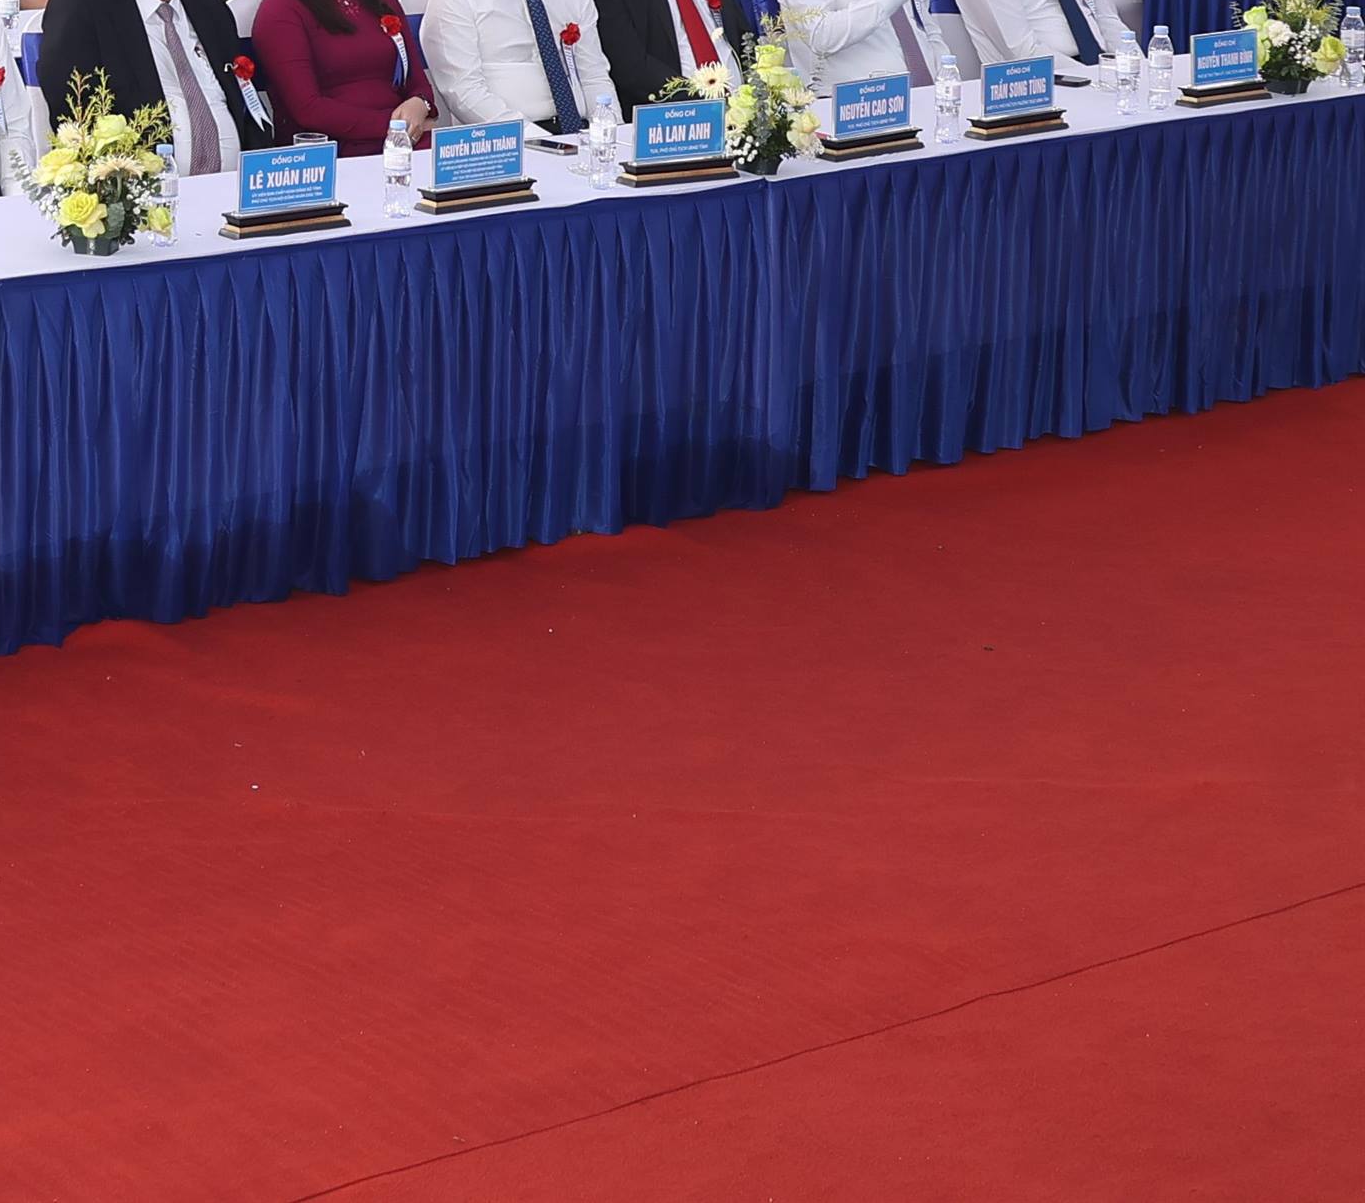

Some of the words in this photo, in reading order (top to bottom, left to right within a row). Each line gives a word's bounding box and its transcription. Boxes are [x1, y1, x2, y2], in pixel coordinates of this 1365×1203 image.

[1006, 67, 1021, 76] ĐỒNG
[1022, 64, 1031, 73] CHÍ
[1197, 50, 1221, 70] NGUYỄN
[1221, 52, 1238, 66] THANH
[859, 85, 875, 95] ĐỒNG
[876, 83, 885, 92] CHÍ
[990, 78, 1008, 101] TRẦN
[1009, 80, 1028, 98] SONG
[1029, 75, 1046, 95] TÙNG
[665, 109, 683, 118] ĐỒNG
[685, 108, 695, 116] CHÍ
[840, 96, 870, 122] NGUYỄN
[872, 98, 887, 117] CAO
[888, 95, 904, 114] SƠN
[471, 129, 486, 138] ÔNG
[649, 123, 663, 144] HÀ
[666, 124, 686, 142] LAN
[689, 122, 711, 141] ANH
[440, 139, 469, 159] NGUYỄN
[471, 138, 491, 155] XUÂN
[493, 135, 517, 152] THÀNH
[271, 156, 292, 165] ĐỒNG
[293, 153, 306, 162] CHÍ
[249, 170, 263, 190] LÊ
[266, 167, 299, 188] XUÂN
[302, 167, 325, 184] HUY
